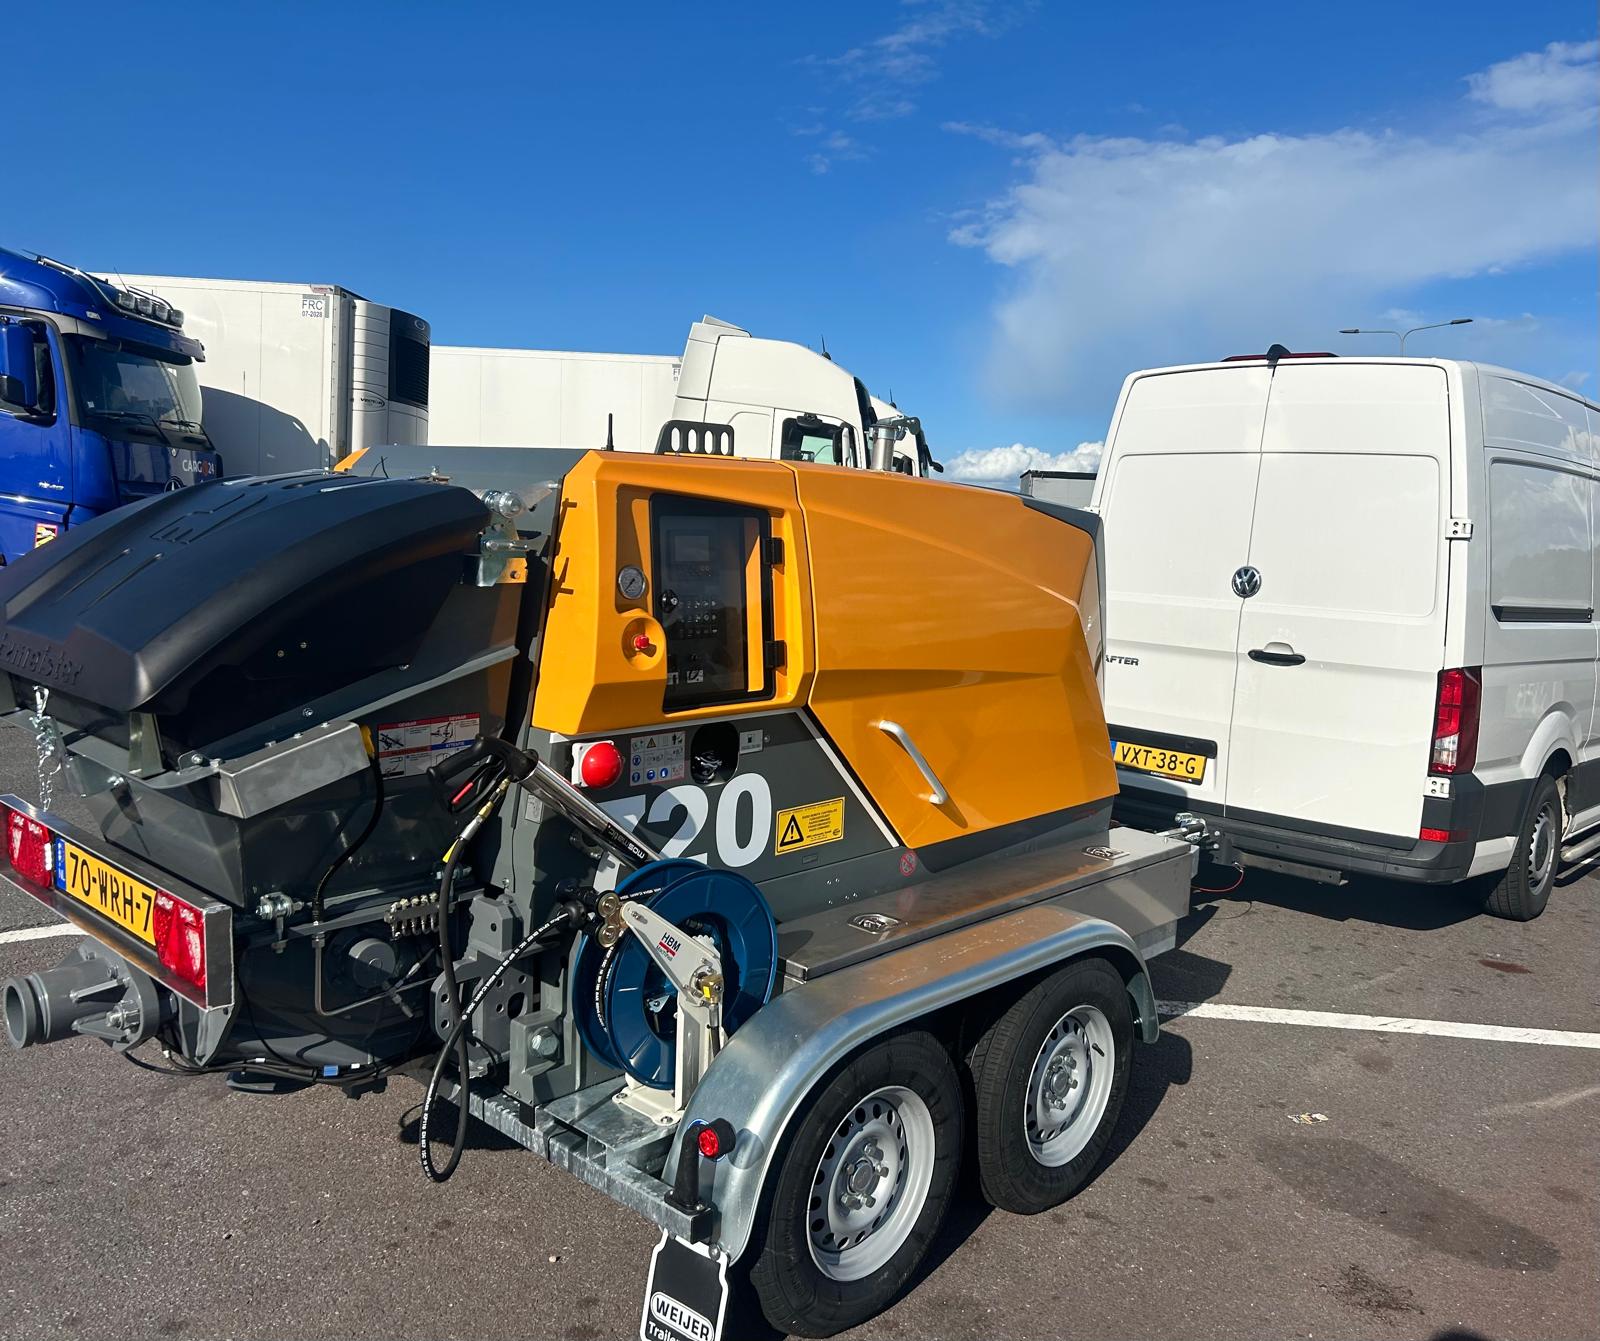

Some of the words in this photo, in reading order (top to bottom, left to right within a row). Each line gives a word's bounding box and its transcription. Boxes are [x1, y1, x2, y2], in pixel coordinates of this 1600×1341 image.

[302, 300, 323, 310] FRC
[1121, 745, 1196, 775] VXT-38-G
[69, 851, 153, 933] 70-WRH-7
[661, 932, 681, 952] HBM
[648, 1320, 683, 1341] Traile
[656, 1297, 710, 1341] WEIJER
